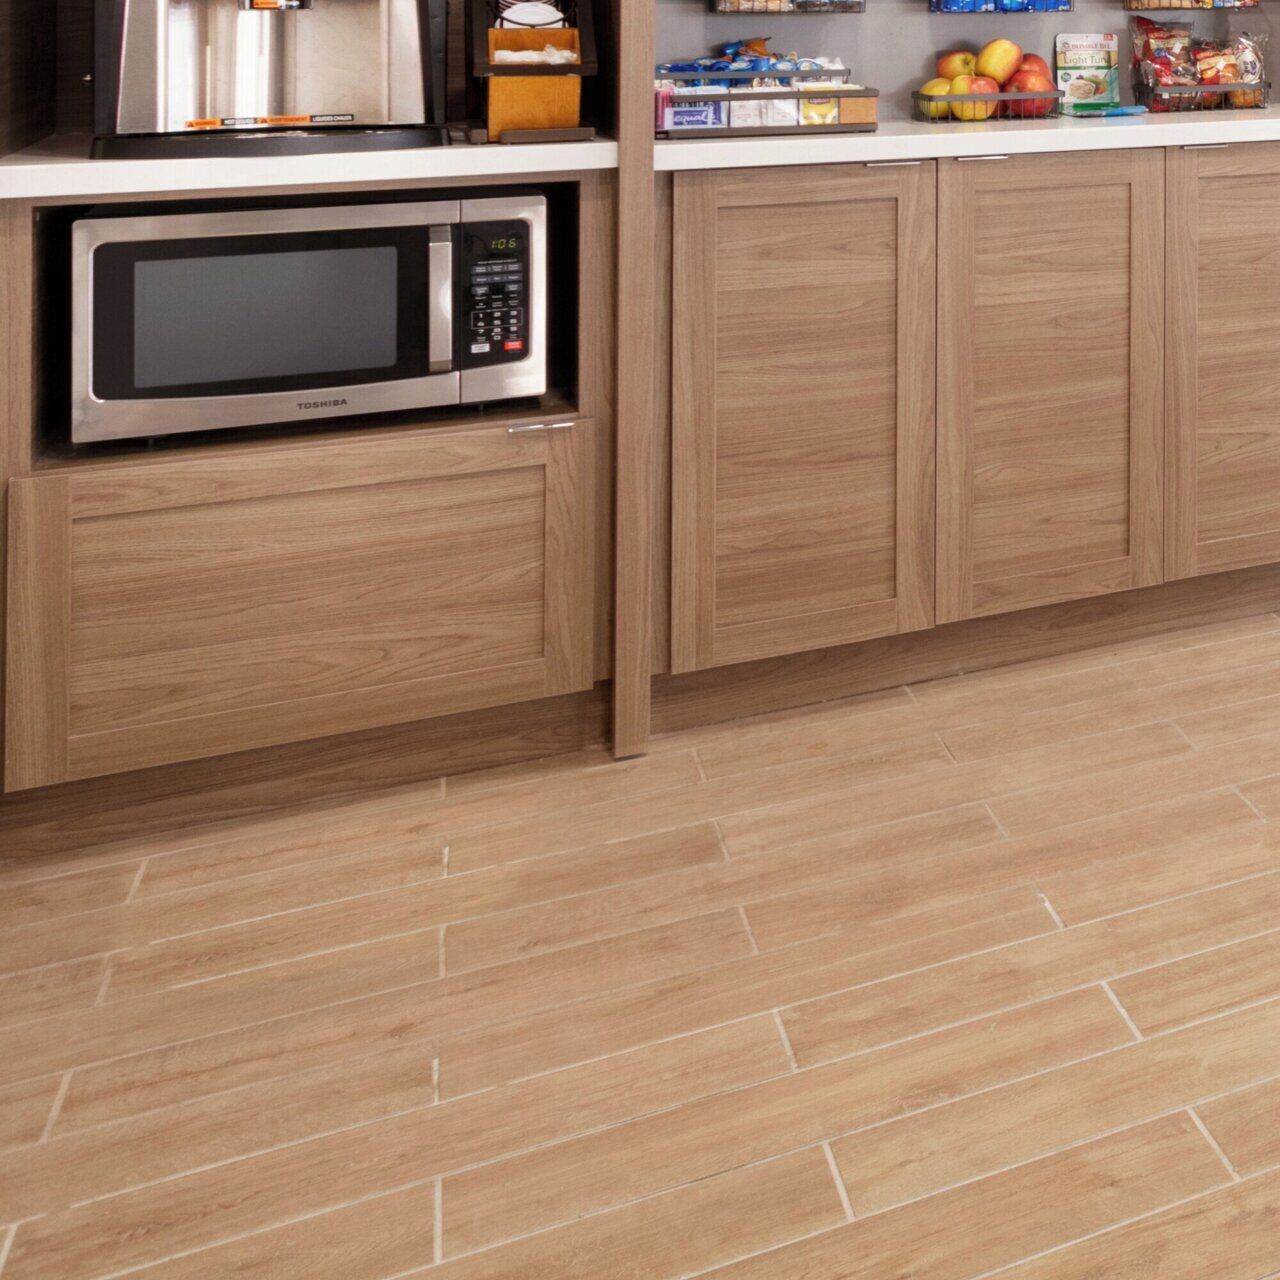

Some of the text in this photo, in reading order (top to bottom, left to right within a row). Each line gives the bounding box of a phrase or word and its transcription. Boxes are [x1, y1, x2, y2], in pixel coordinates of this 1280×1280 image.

[1064, 56, 1109, 65] Light Tun
[673, 109, 708, 124] equal
[492, 239, 516, 248] 1:06
[297, 397, 348, 410] TOSHIBA
